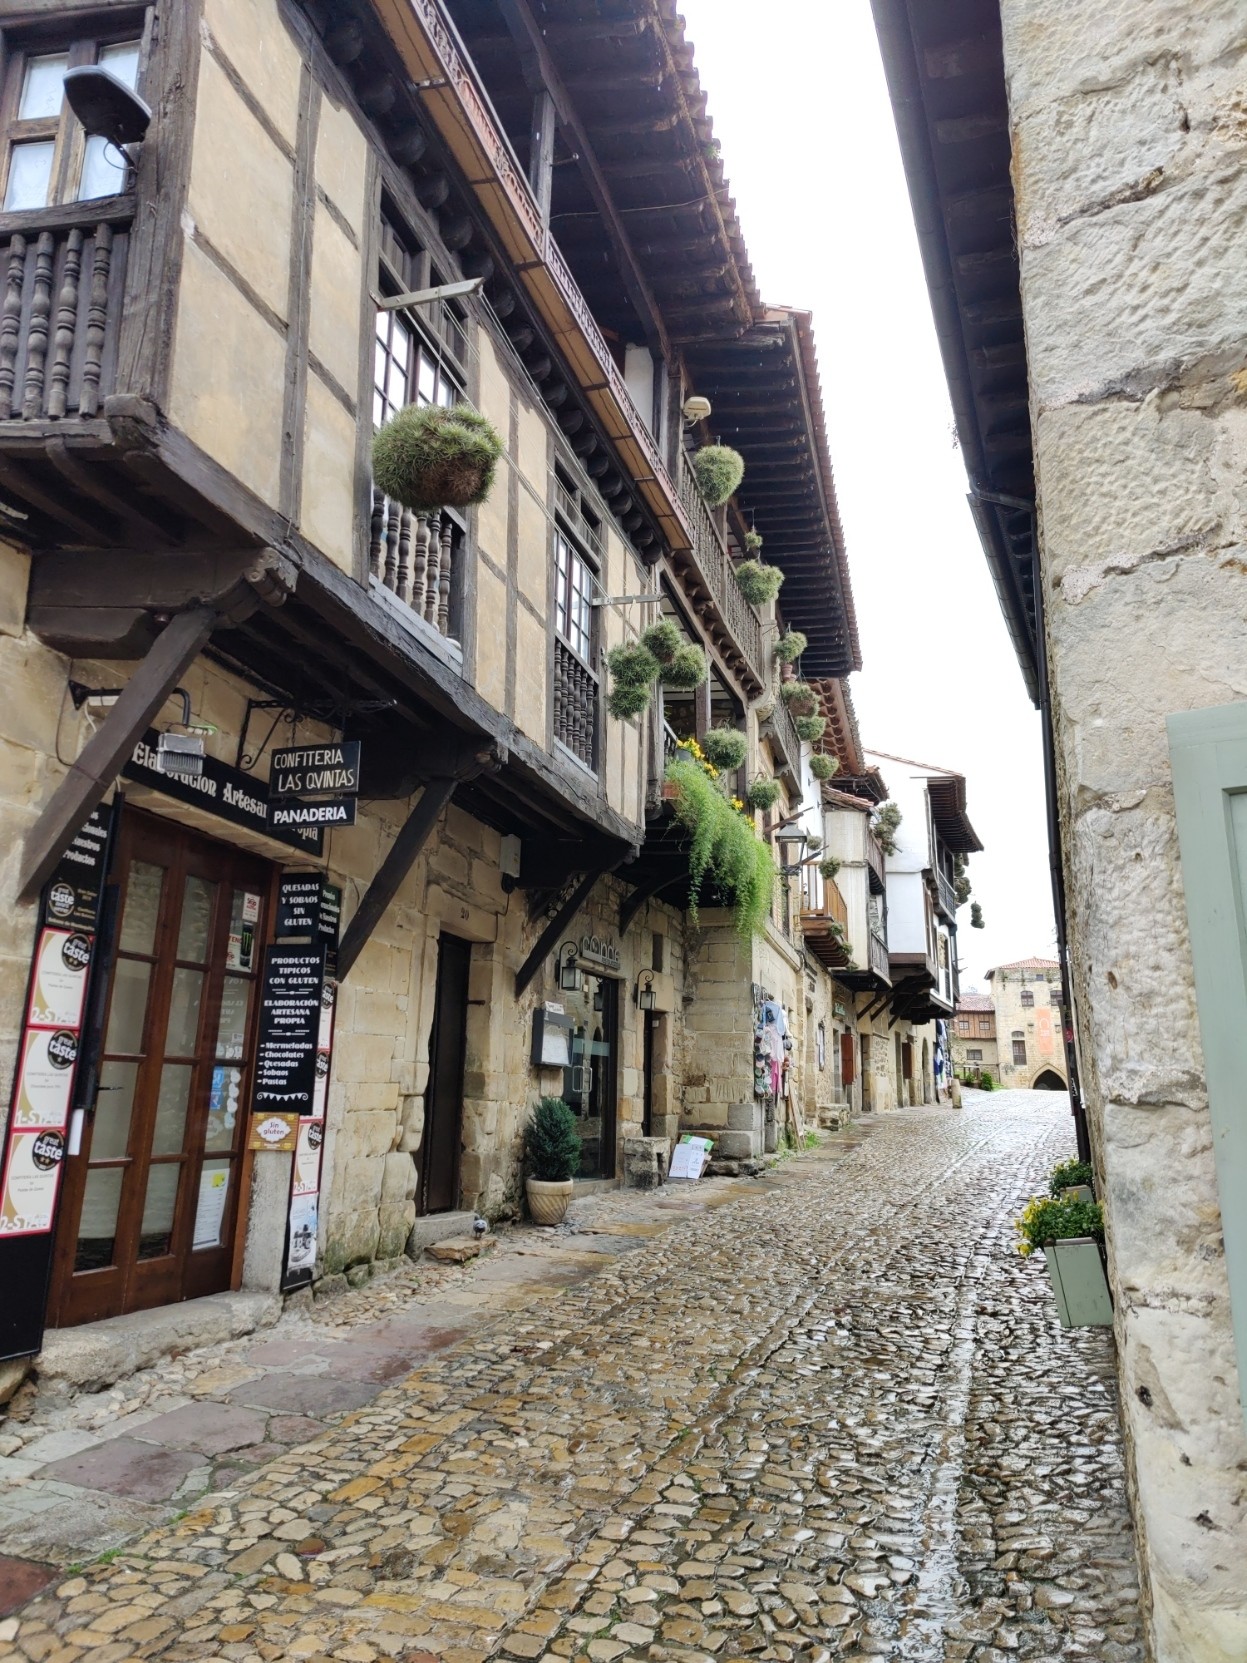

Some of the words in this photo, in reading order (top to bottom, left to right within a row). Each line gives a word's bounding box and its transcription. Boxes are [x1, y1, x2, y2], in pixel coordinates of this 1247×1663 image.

[274, 749, 344, 769] CONFITERIA
[278, 773, 301, 792] LAS
[306, 769, 354, 789] QVINTAS
[273, 806, 347, 824] PANADERIA
[282, 883, 319, 893] QUESADAS
[51, 891, 75, 905] taste
[289, 896, 318, 904] SOBAOS
[293, 907, 305, 915] SIN
[284, 918, 312, 926] GLUTEN
[63, 942, 90, 963] taste
[269, 977, 285, 985] CON
[264, 999, 319, 1007] ELABORACIÓN
[49, 1040, 77, 1060] taste
[263, 1128, 285, 1136] gluten
[34, 1140, 63, 1160] taste
